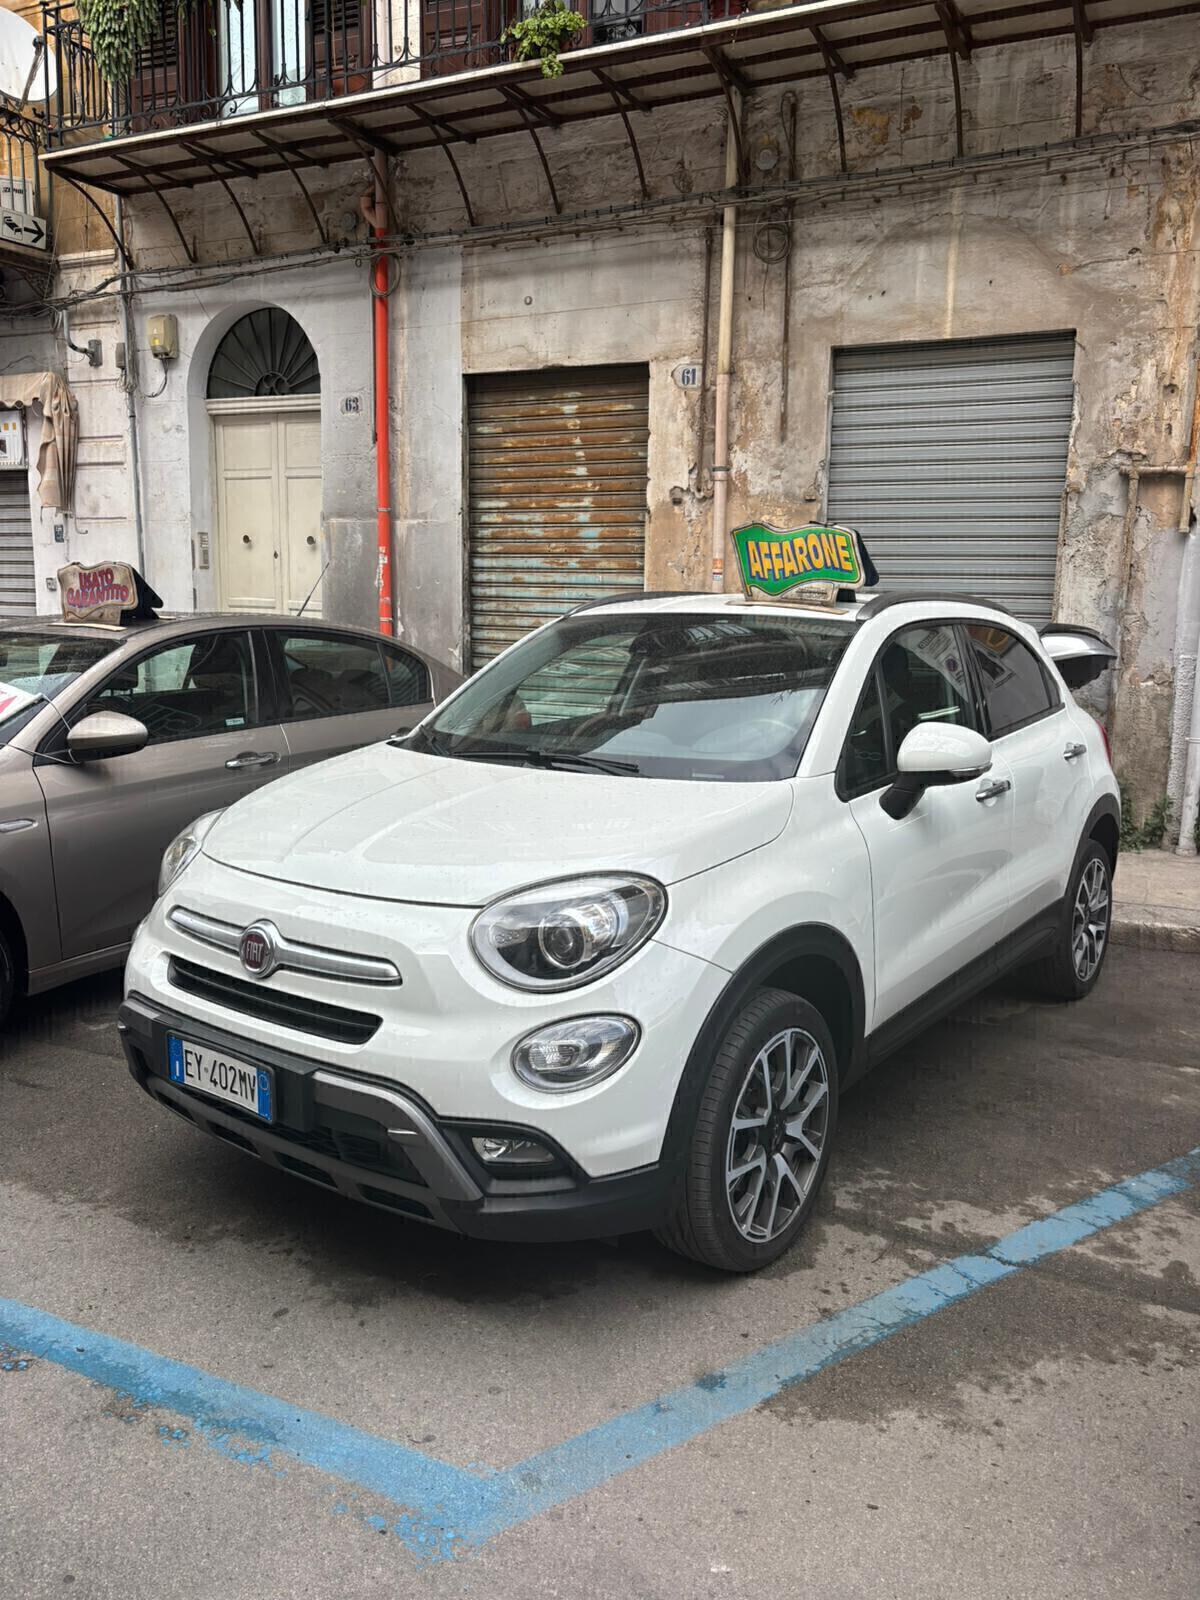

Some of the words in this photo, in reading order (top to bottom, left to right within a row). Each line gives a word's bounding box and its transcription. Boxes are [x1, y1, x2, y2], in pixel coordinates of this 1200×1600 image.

[682, 368, 697, 386] 61
[345, 397, 359, 412] 63
[747, 533, 853, 580] AFFARONE
[79, 567, 114, 592] USATO
[66, 583, 129, 608] GARANTITO
[246, 940, 264, 963] FIAT
